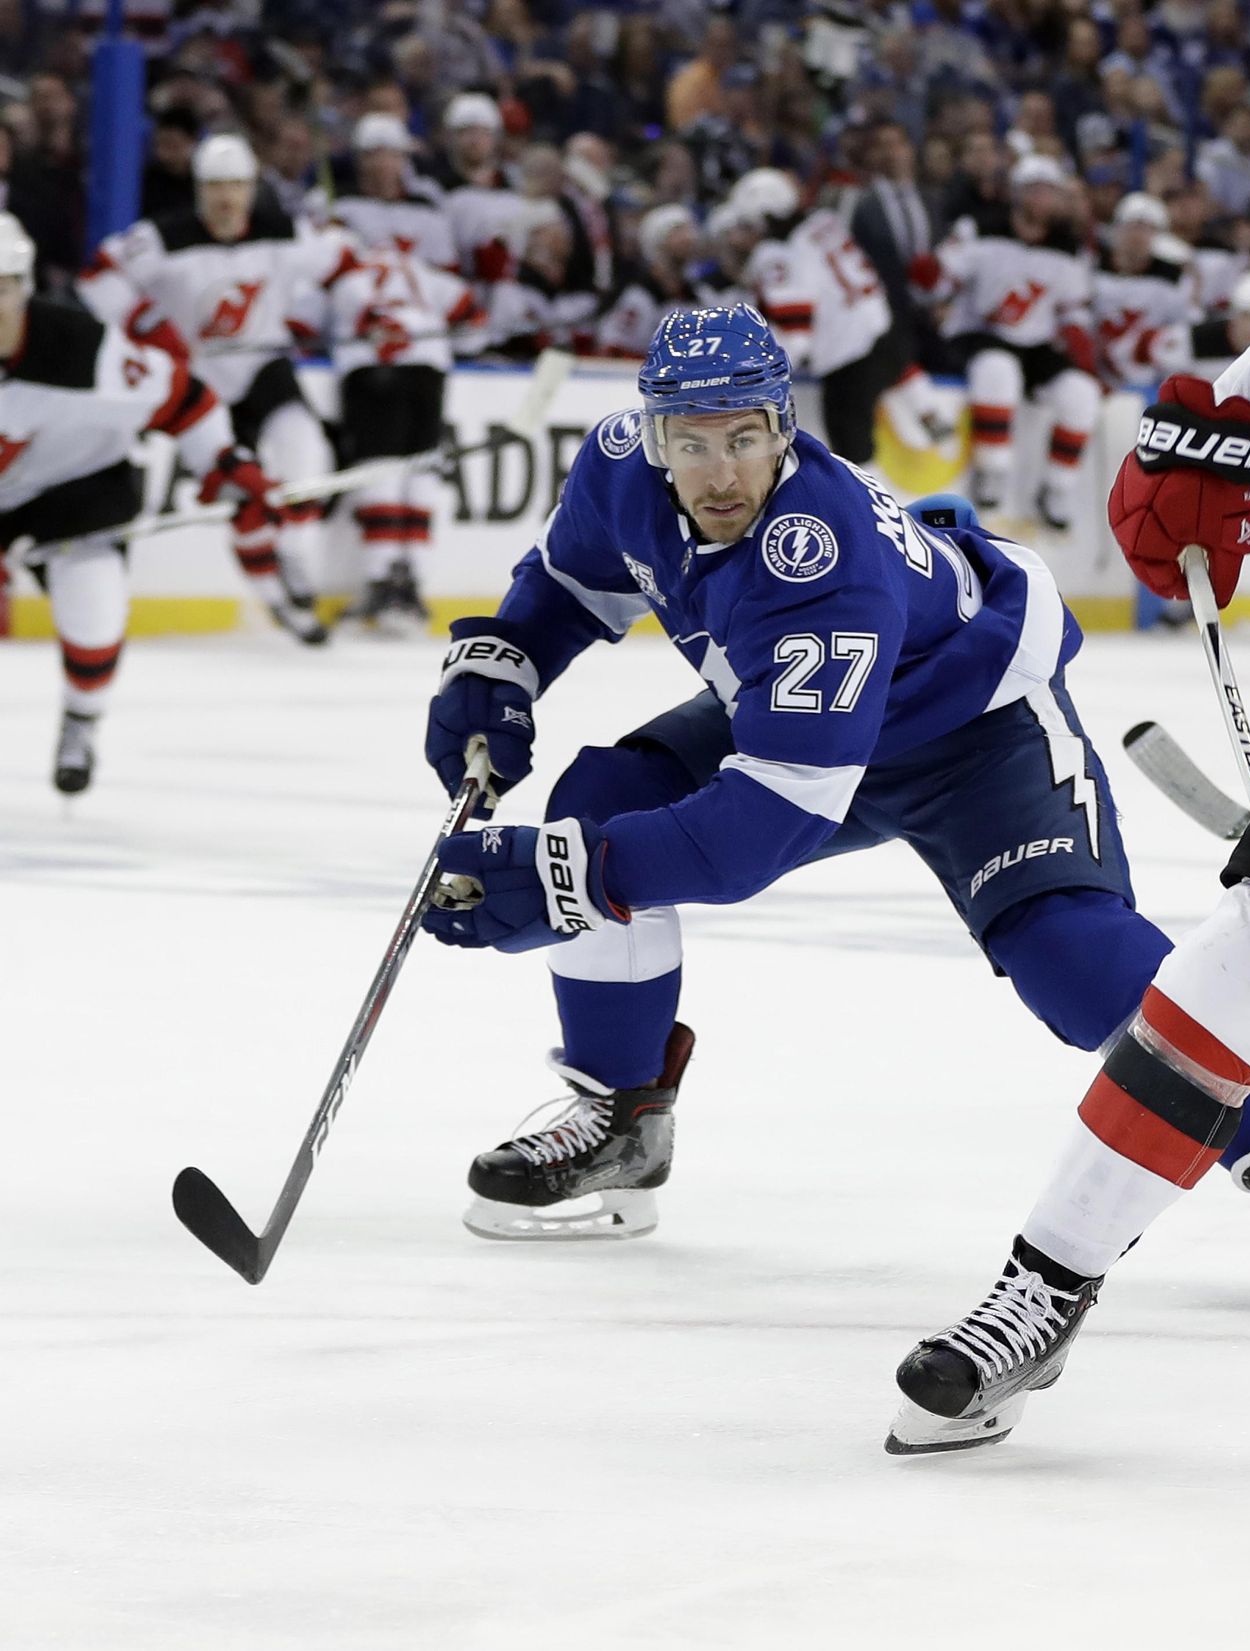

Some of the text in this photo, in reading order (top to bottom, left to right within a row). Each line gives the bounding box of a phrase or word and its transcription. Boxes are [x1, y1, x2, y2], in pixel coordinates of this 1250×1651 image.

[687, 336, 723, 358] 27
[679, 376, 731, 390] BAUER
[768, 540, 787, 573] TAMPA
[793, 518, 833, 559] LIGHTNING
[770, 631, 879, 714] 27
[970, 837, 1075, 900] BAUER
